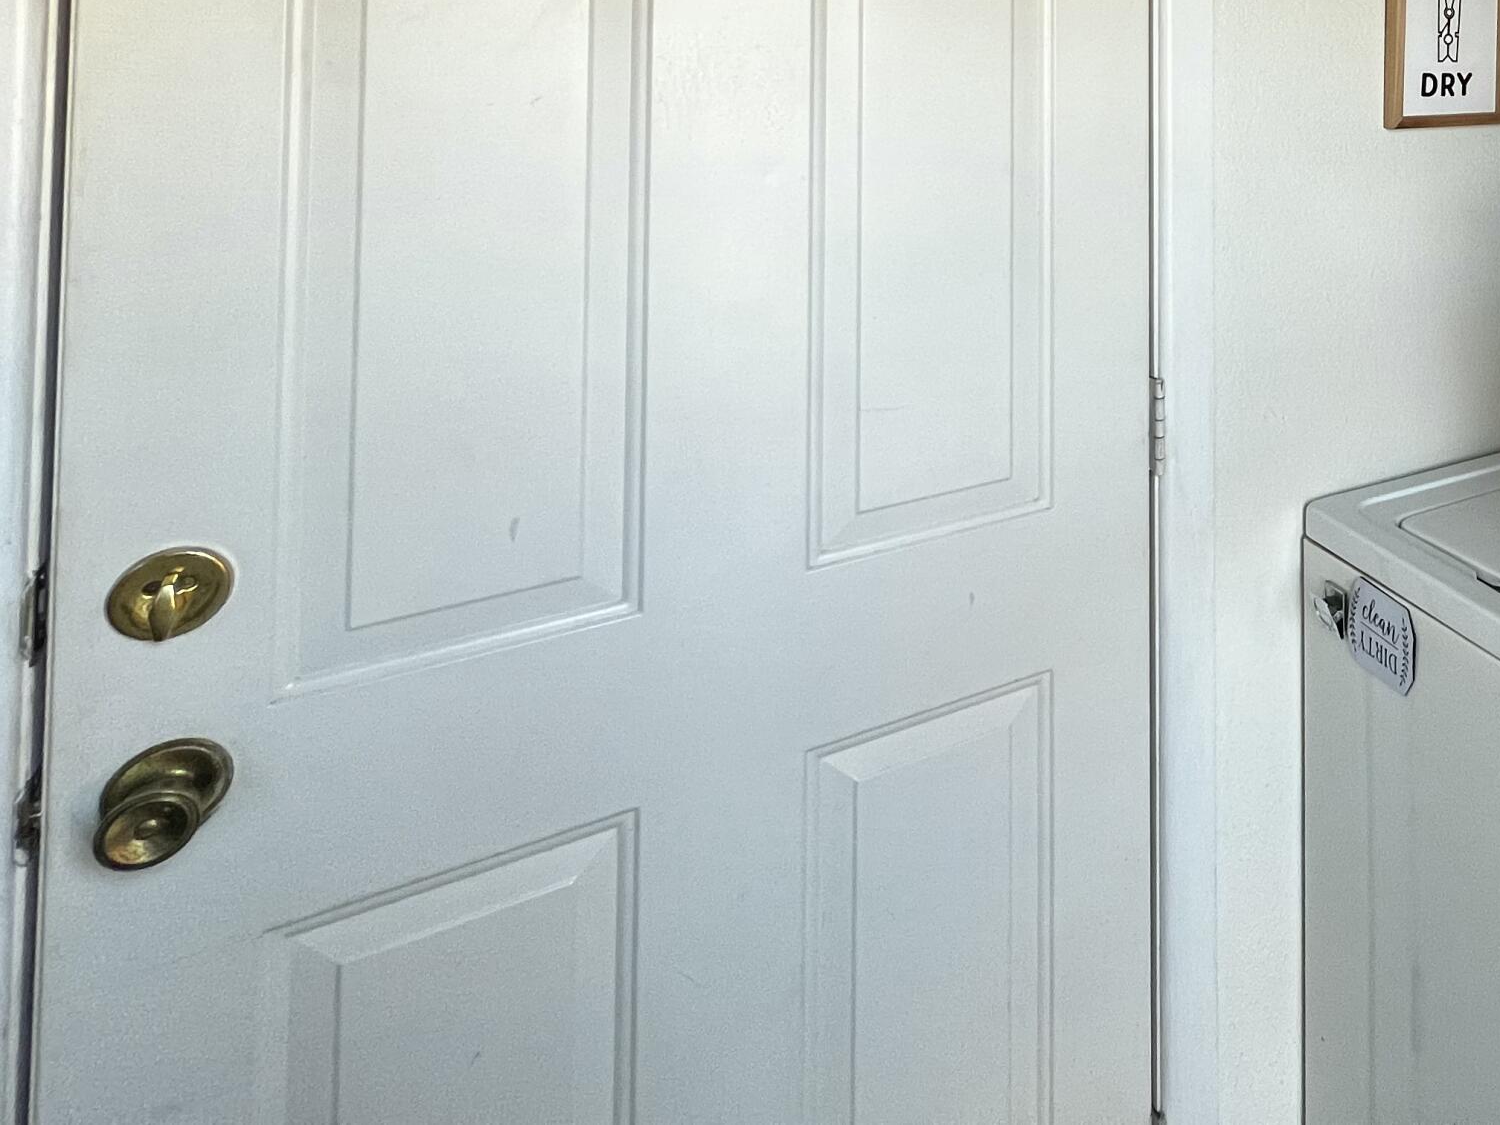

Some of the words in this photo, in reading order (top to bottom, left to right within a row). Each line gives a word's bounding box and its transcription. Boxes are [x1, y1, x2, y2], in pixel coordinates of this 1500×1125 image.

[1420, 71, 1473, 98] DRY
[1362, 599, 1400, 644] clean
[1358, 630, 1398, 675] DIRTY
